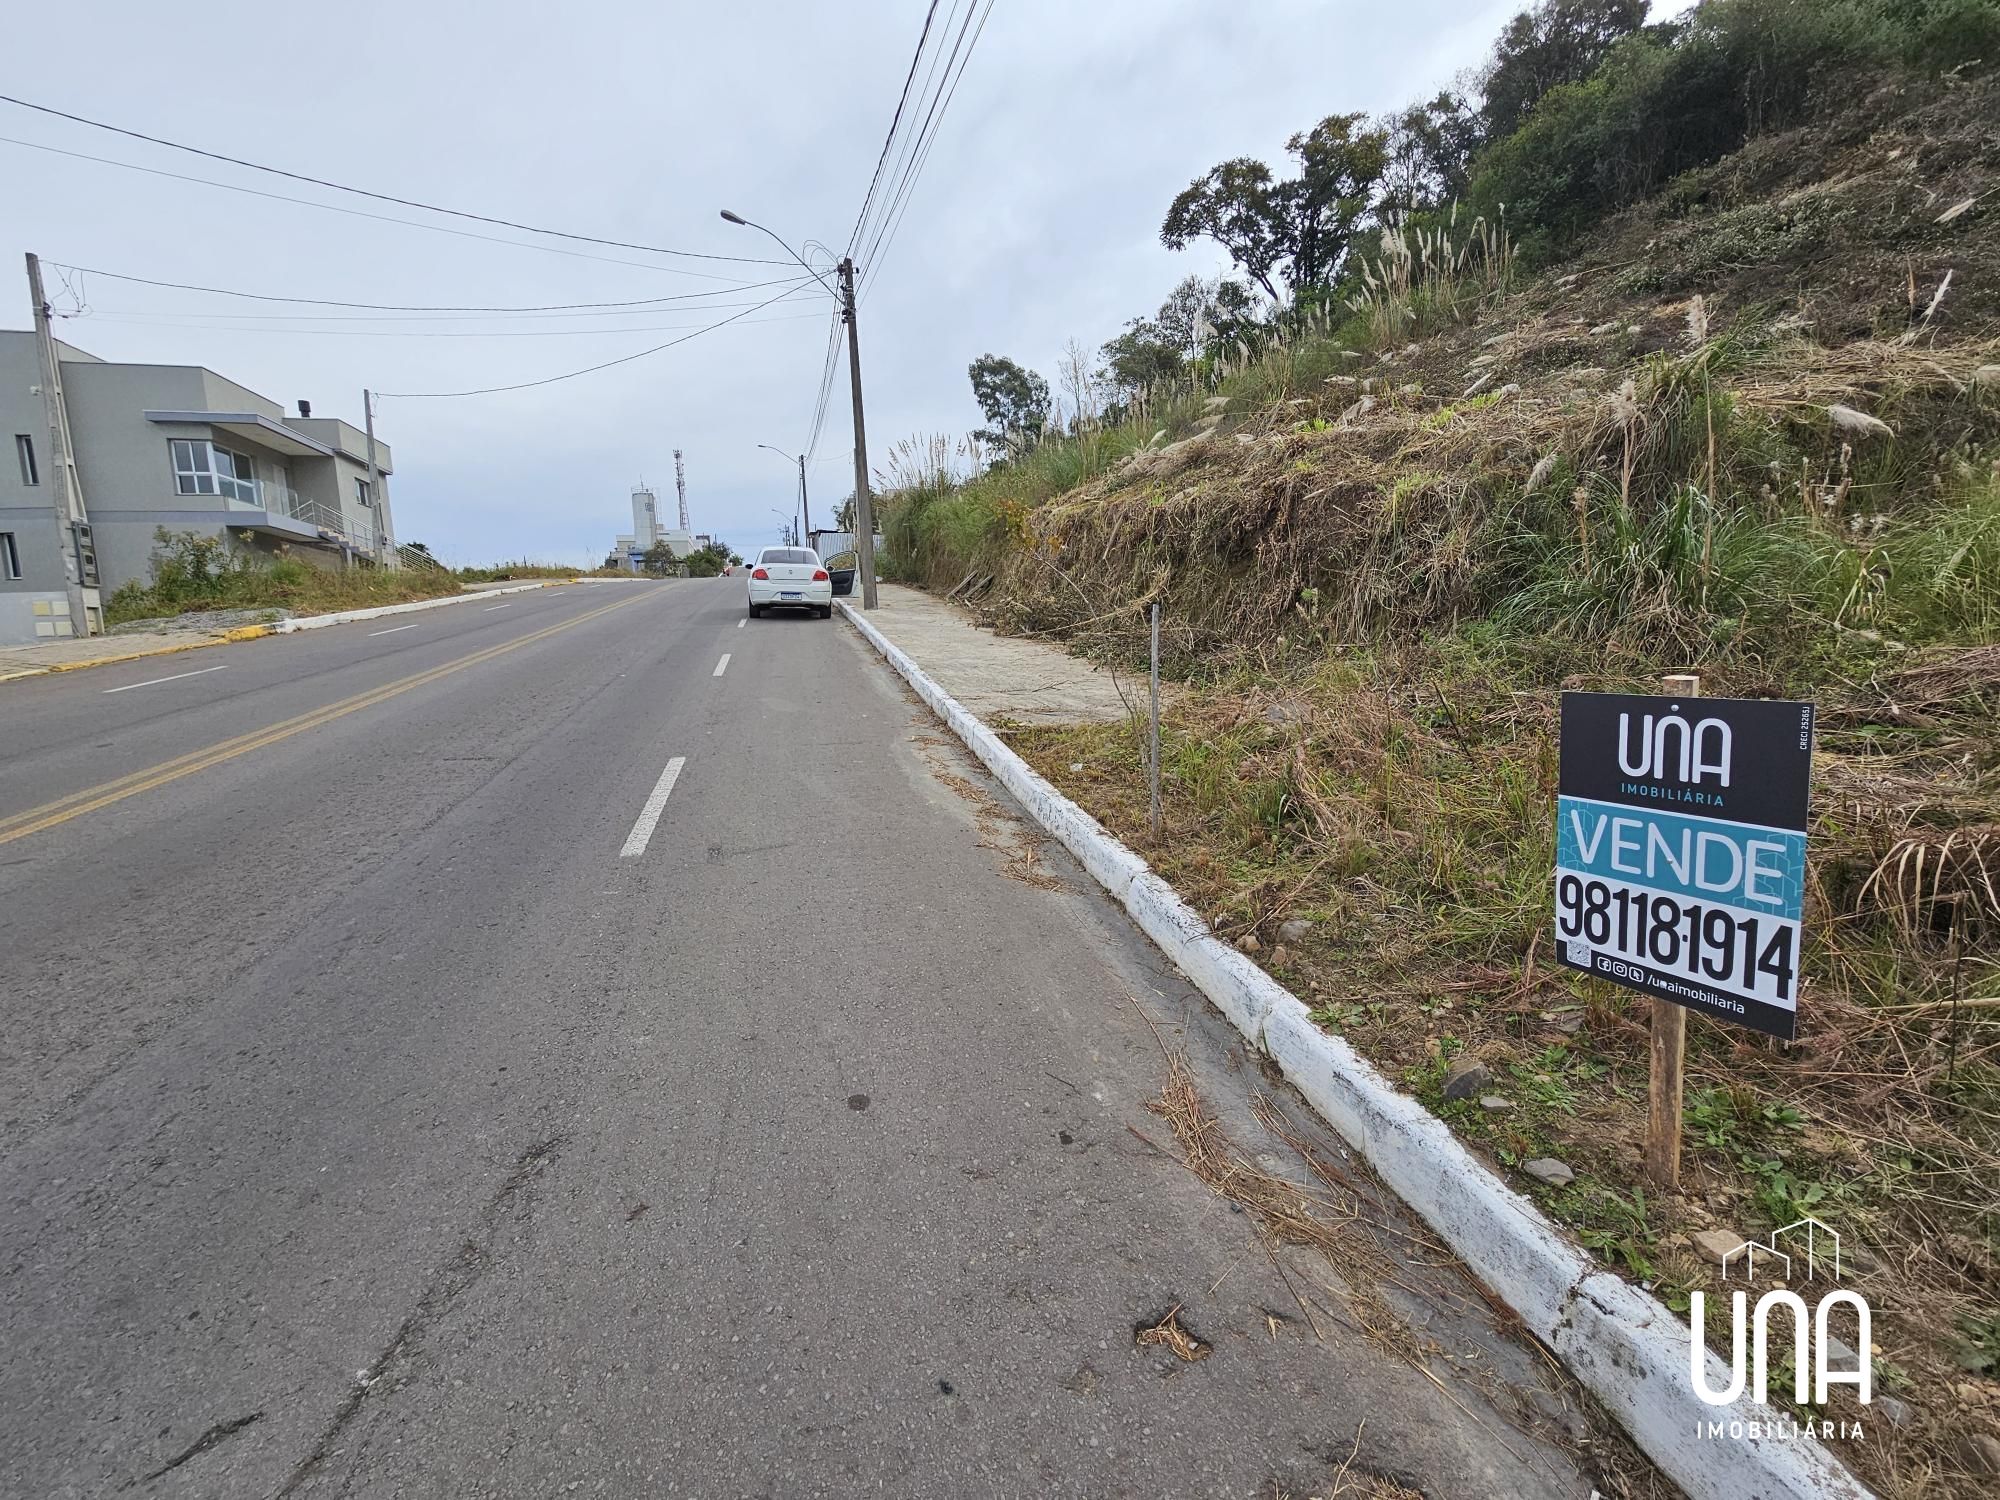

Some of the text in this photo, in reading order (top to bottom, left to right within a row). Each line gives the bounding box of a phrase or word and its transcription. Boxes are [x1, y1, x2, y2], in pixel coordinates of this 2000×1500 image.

[1618, 713, 1732, 788] UNA
[1800, 731, 1808, 750] CRECI
[1621, 782, 1724, 807] IMOBILIÁRIA
[1570, 809, 1787, 906] VENDE
[1647, 974, 1745, 1014] /uaimobiliaria
